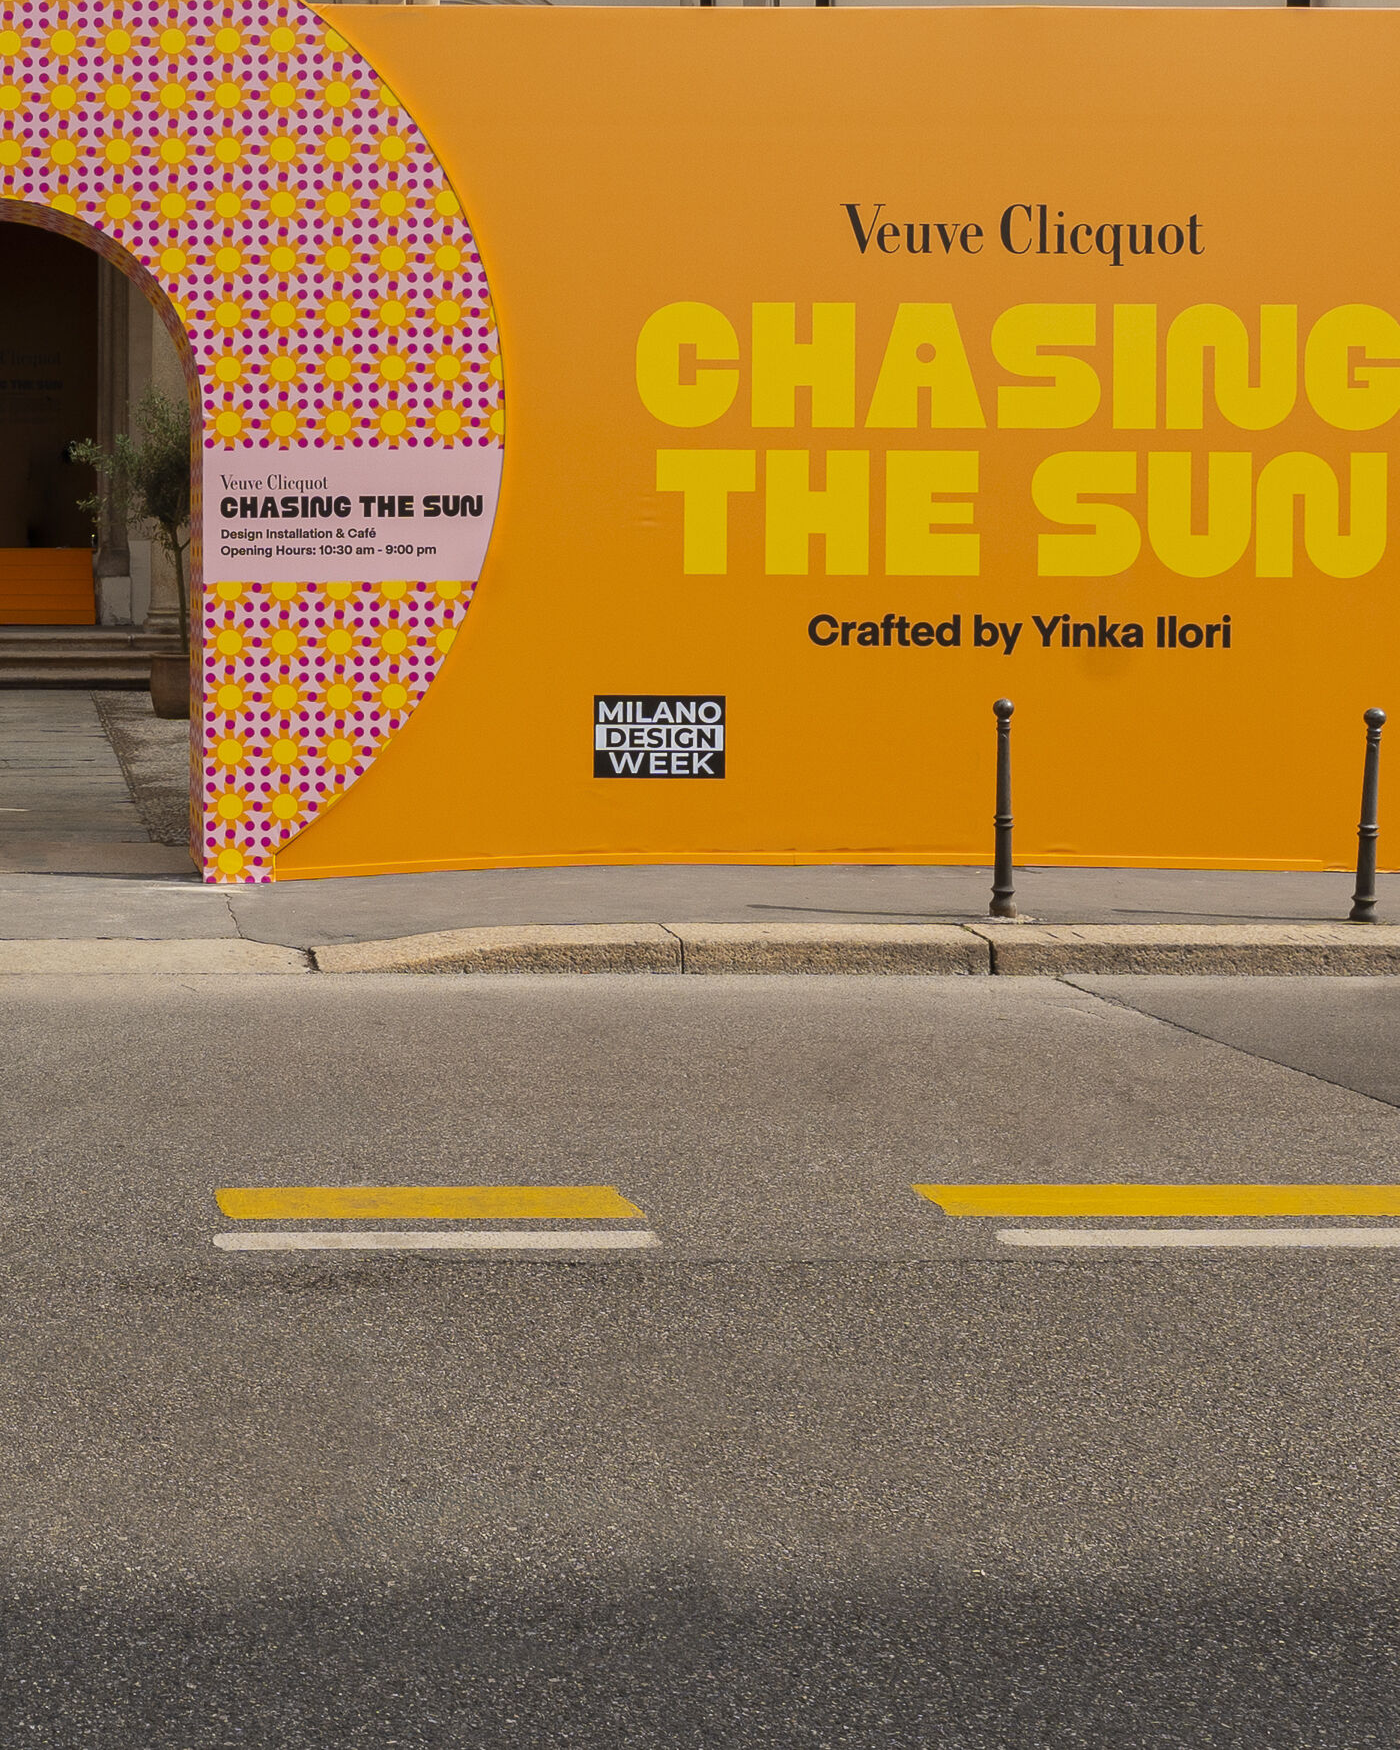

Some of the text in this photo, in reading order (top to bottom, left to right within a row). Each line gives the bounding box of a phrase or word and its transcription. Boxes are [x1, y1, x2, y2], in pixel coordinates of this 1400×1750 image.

[839, 203, 1206, 267] Veuve Clicquot
[636, 302, 1400, 430] CHASING
[220, 474, 328, 493] Veuve Clicquot
[220, 495, 483, 518] CHASING THE SUN
[656, 450, 1387, 578] THE SUN
[221, 527, 376, 541] Design Installation & Café
[221, 545, 272, 558] Opening
[276, 545, 316, 556] Hours:
[319, 544, 352, 555] 10:30
[356, 546, 375, 555] am
[385, 544, 413, 555] 9:00
[416, 546, 437, 557] pm
[807, 614, 1232, 655] Crafted by Yinka Ilori
[598, 701, 722, 723] MILANO
[605, 727, 716, 749] DESIGN
[608, 752, 715, 775] WEEK
